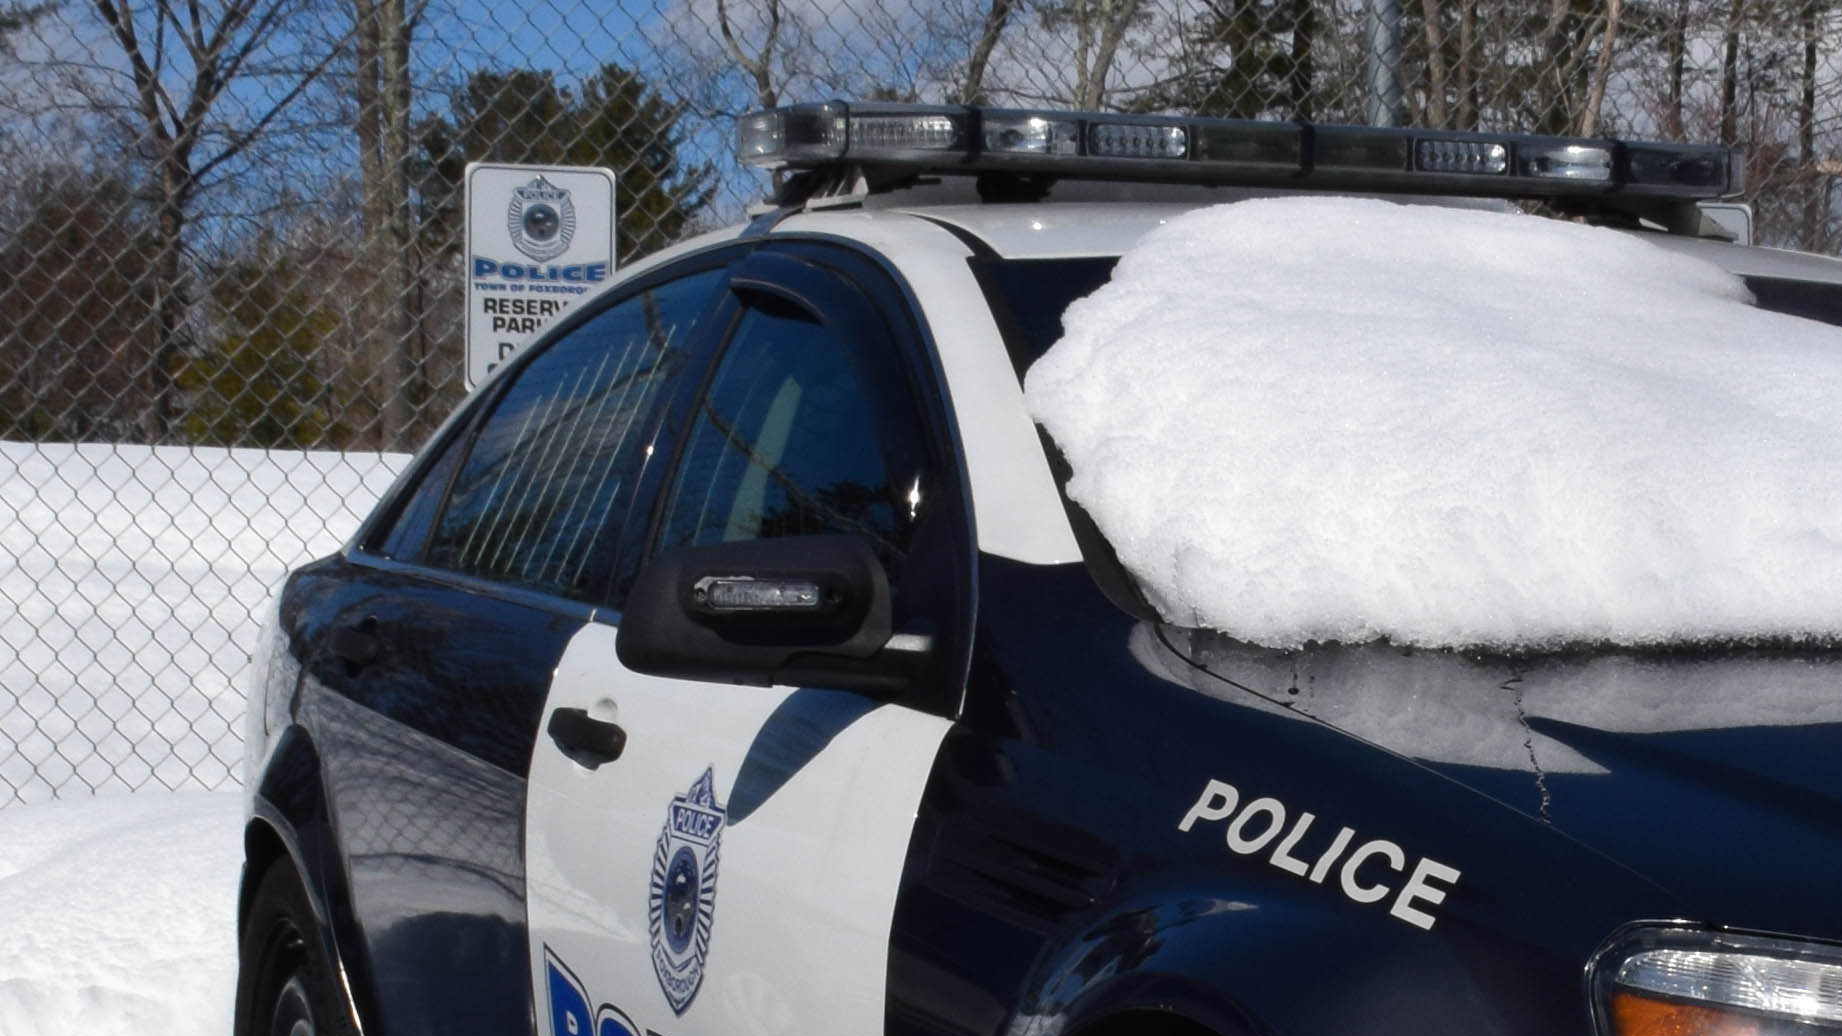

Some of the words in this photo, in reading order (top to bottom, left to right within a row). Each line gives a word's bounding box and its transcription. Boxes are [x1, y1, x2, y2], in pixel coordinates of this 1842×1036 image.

[474, 256, 609, 283] POLICE
[474, 283, 506, 291] TOWN
[510, 284, 525, 292] OF
[529, 285, 588, 295] FOXBORO
[675, 808, 715, 838] POLICE
[1178, 778, 1462, 931] POLICE
